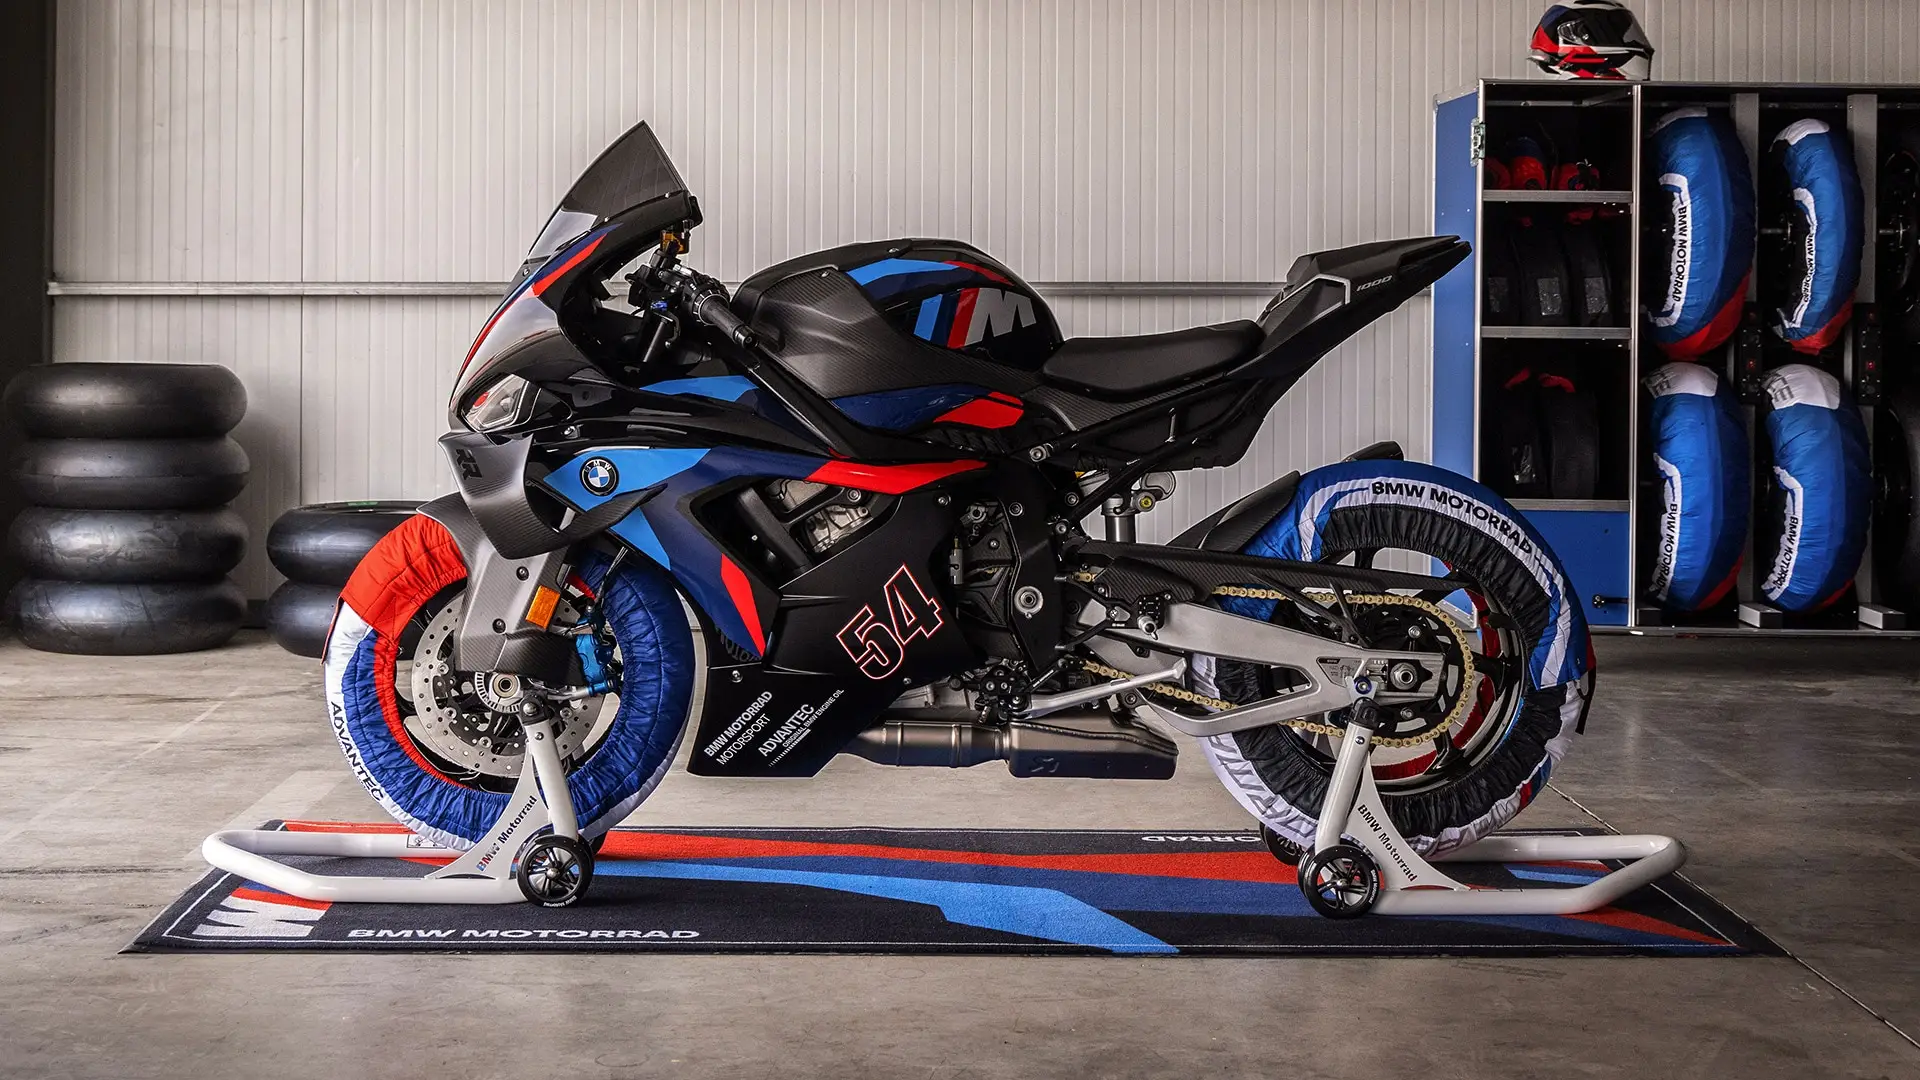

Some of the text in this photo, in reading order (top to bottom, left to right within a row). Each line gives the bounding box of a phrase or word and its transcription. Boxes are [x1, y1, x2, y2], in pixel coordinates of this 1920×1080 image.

[1356, 275, 1392, 292] 1000
[1672, 206, 1688, 303] BMW MOTORRAD
[965, 287, 1038, 347] M
[455, 447, 483, 481] RR
[584, 459, 613, 473] BMW
[1371, 481, 1532, 554] BMW MOTORRAD
[1787, 516, 1799, 546] BMW
[835, 561, 945, 680] 54
[703, 690, 773, 757] BMW MOTORRAD
[715, 713, 771, 765] MOTORSPORT
[757, 703, 815, 757] ADVANTEC
[782, 689, 845, 748] ORIGINAL BMW ENGINE OIL
[330, 701, 384, 802] ADVANTEC
[475, 795, 537, 872] BMW Motorrad
[1357, 803, 1418, 882] BMW Motorrad
[346, 929, 701, 940] BMW MOTORRAD
